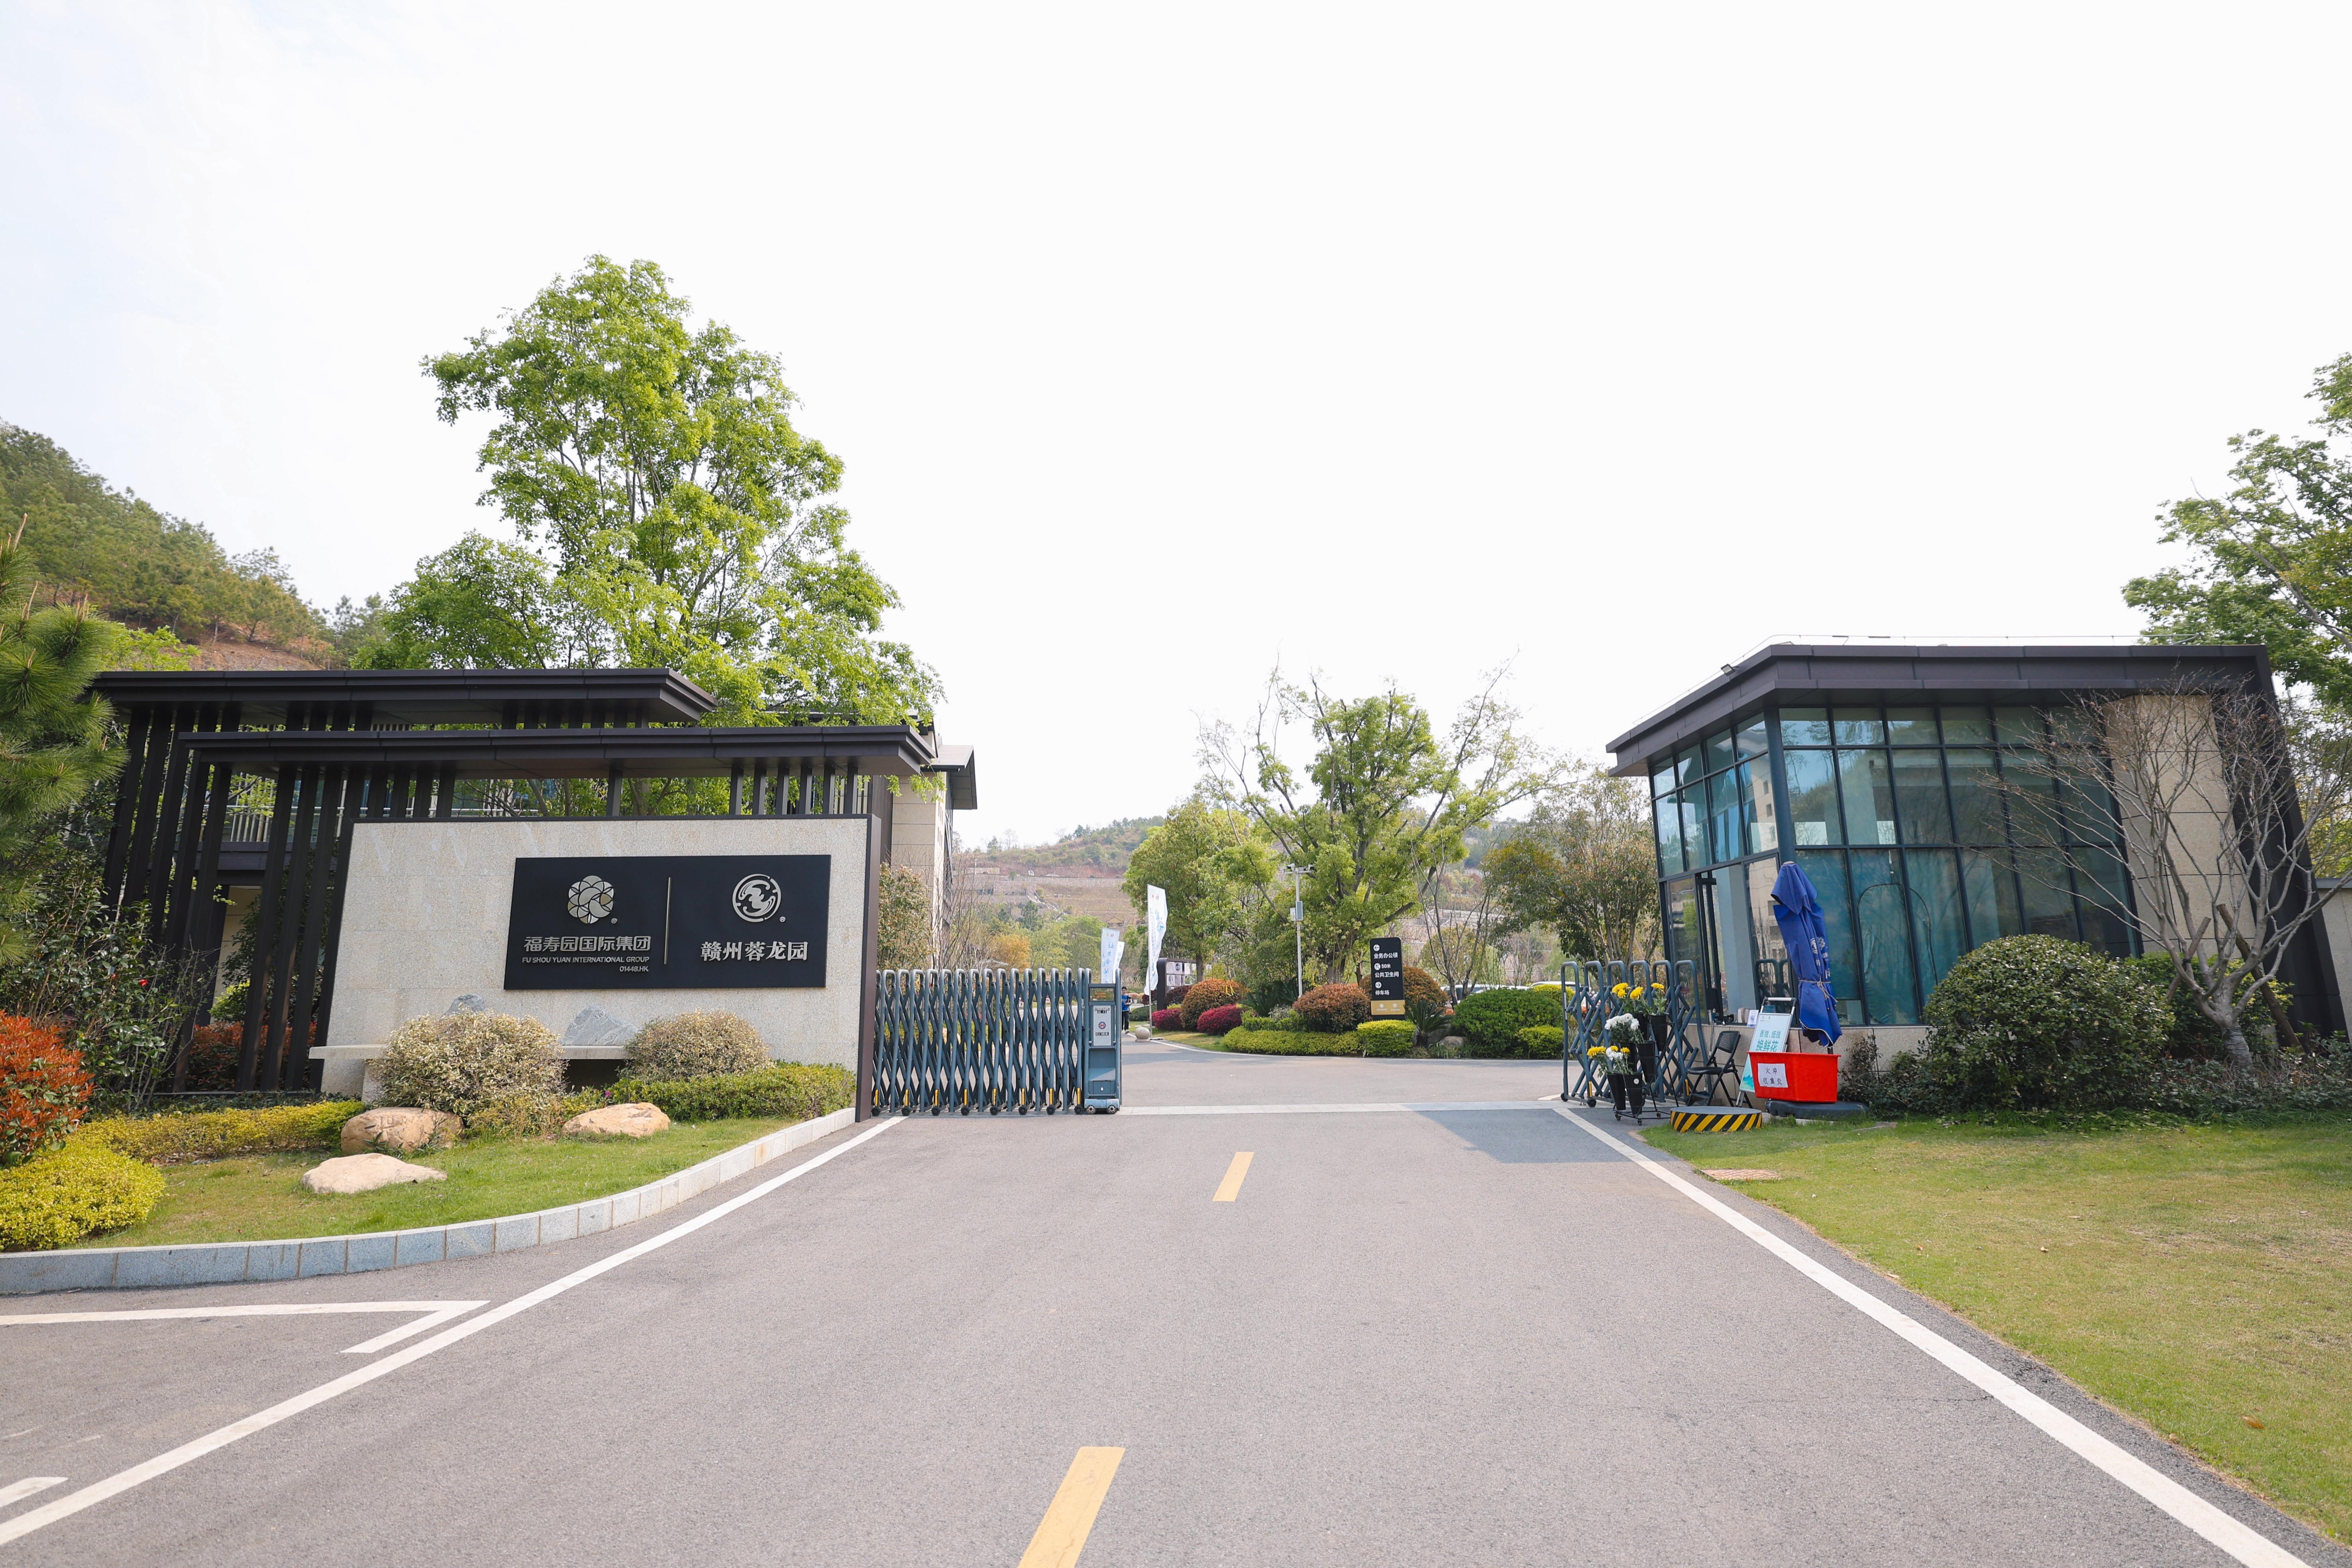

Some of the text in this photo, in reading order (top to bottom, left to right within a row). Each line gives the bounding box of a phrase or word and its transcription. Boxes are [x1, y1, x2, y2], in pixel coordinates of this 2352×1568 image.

[524, 936, 651, 952] 福寿园国际集团
[700, 941, 808, 961] 赣州蓉龙园
